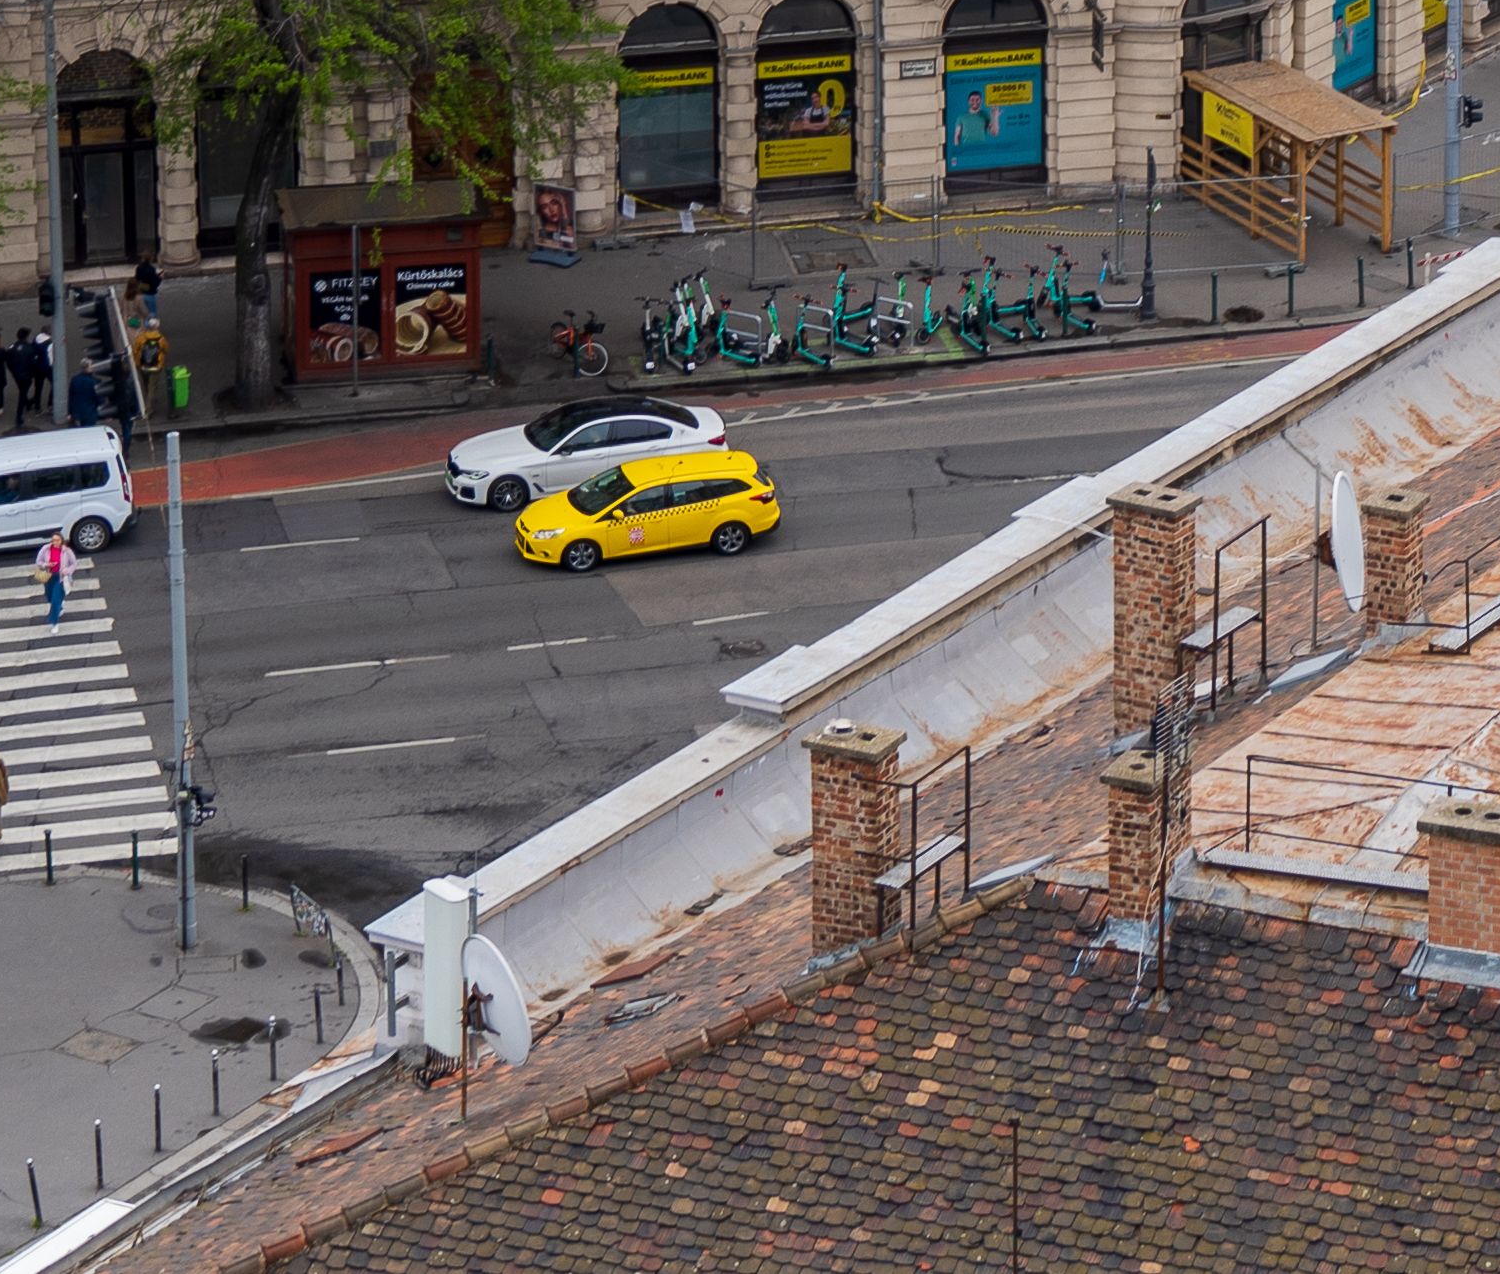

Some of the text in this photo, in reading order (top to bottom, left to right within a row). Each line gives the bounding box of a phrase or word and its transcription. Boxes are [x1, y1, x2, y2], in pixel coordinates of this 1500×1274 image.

[961, 52, 1035, 66] RaiffeisenBANK
[771, 59, 845, 74] RaiffeisenBANK
[642, 71, 707, 84] iffeisenBANK
[397, 268, 464, 281] Kürtőskalács
[332, 276, 379, 288] FITZEY
[406, 281, 437, 290] Chimney
